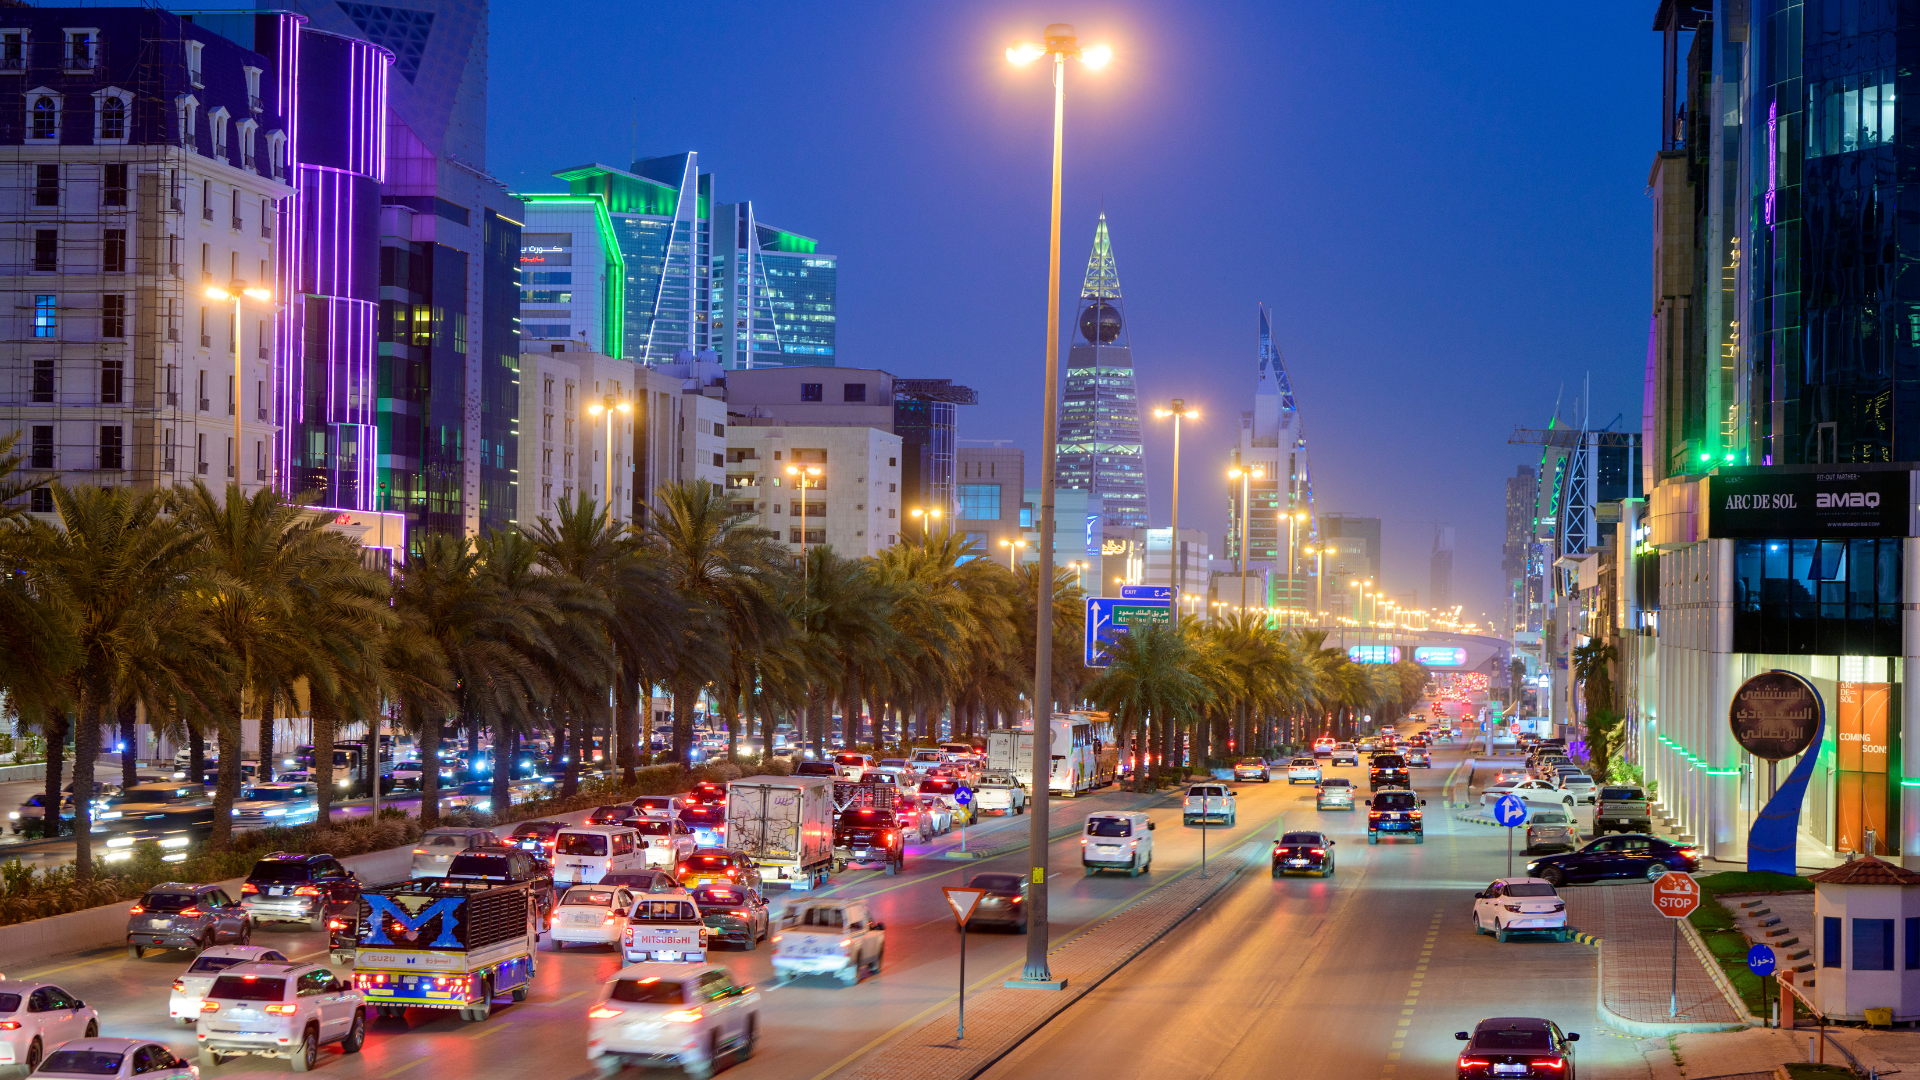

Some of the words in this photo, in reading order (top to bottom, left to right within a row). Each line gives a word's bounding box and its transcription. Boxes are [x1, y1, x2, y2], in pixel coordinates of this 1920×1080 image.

[1725, 494, 1751, 510] ARC
[1752, 494, 1771, 509] DE
[1772, 493, 1797, 509] SOL
[1151, 609, 1169, 617] طريق
[1736, 707, 1812, 722] السعودي
[1740, 726, 1804, 742] البريطاني
[1839, 732, 1871, 742] COMING
[1862, 744, 1887, 754] SOON!
[1091, 821, 1100, 831] 7
[1660, 879, 1692, 895] قف
[1659, 896, 1692, 908] STOP
[641, 935, 691, 945] MITSUBISHI
[368, 955, 396, 963] ISUZU
[1750, 956, 1774, 967] دخول
